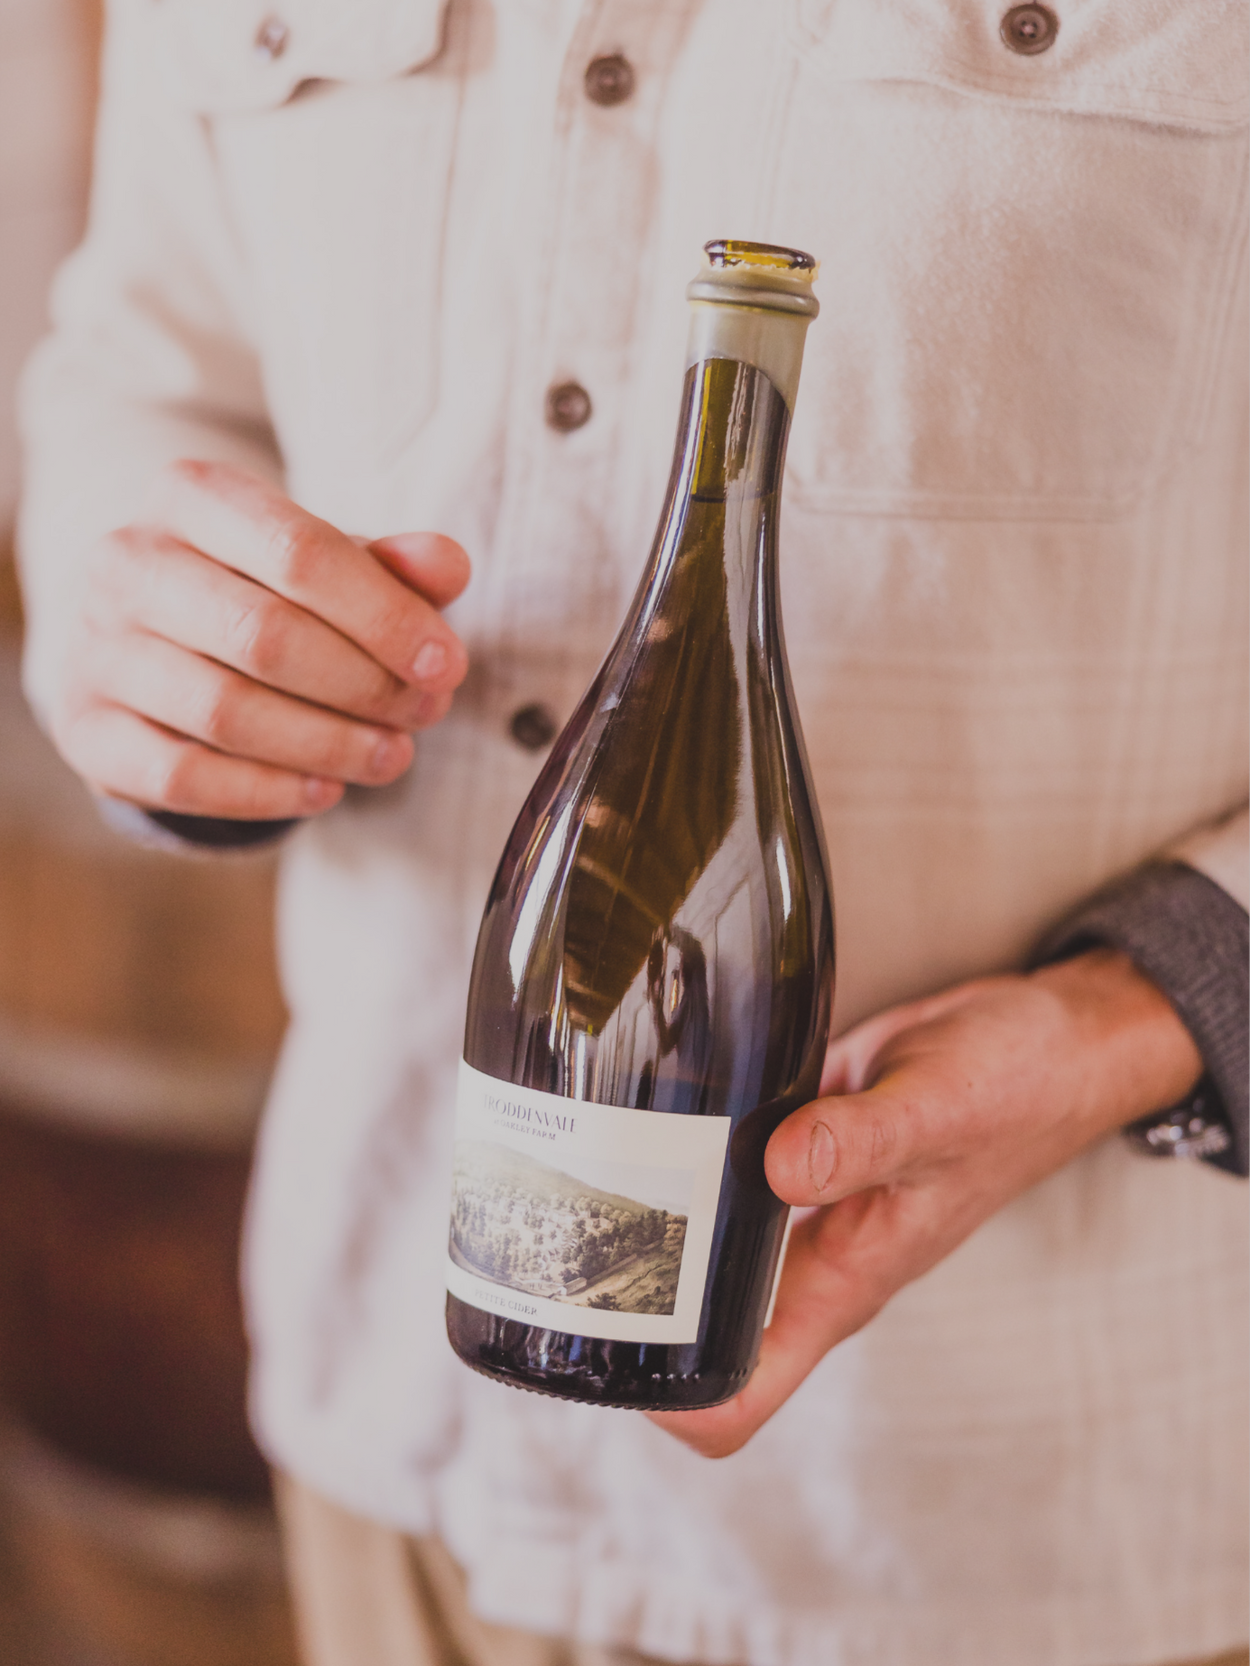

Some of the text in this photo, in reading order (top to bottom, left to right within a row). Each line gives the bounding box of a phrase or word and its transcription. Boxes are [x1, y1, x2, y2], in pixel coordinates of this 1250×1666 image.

[483, 1094, 577, 1134] TRODDENVALE
[500, 1119, 530, 1134] OAKLEY
[532, 1128, 556, 1141] FARM
[475, 1289, 538, 1316] PETITE CIDER
